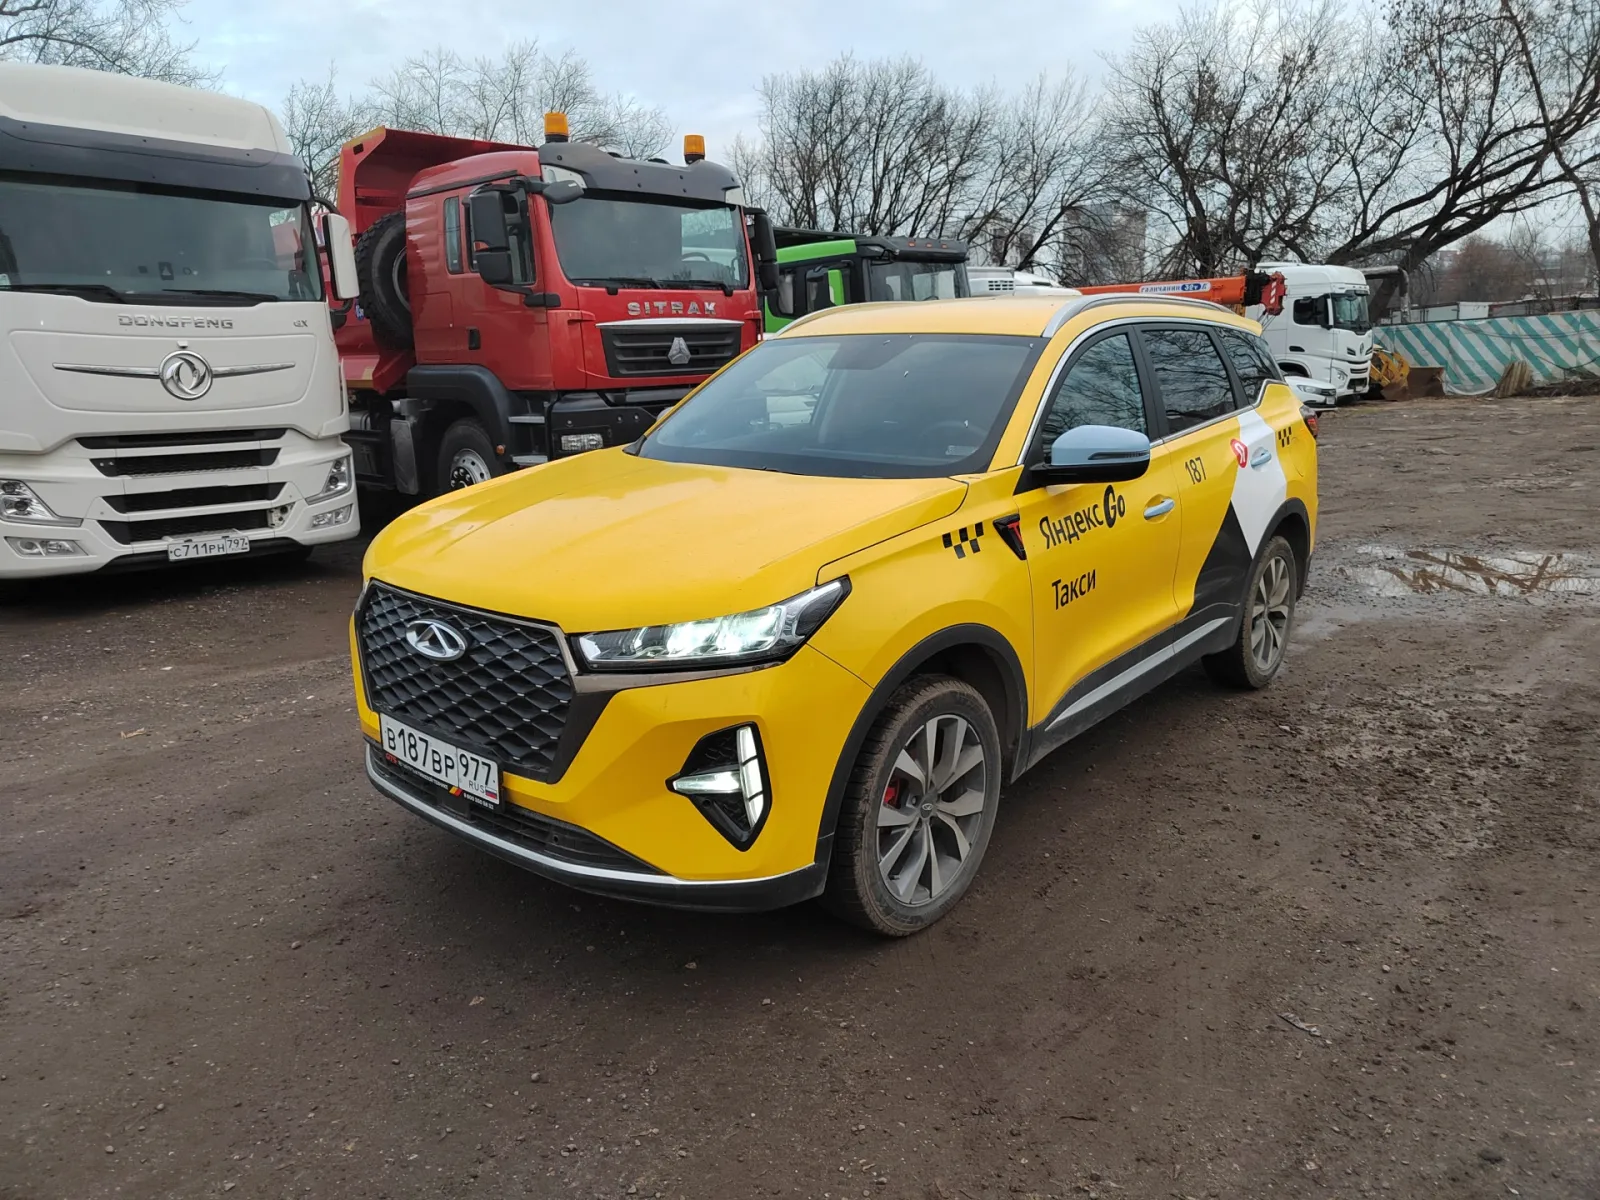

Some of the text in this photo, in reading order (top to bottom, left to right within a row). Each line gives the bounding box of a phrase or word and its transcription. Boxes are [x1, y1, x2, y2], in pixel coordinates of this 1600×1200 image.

[627, 302, 717, 316] SITRAK
[117, 315, 233, 329] DONGFENG
[1184, 456, 1206, 485] 187
[1039, 484, 1126, 549] Яндекс Go
[227, 538, 246, 549] 797
[1051, 568, 1096, 610] Такси
[459, 753, 492, 786] 977
[468, 780, 485, 794] RUS
